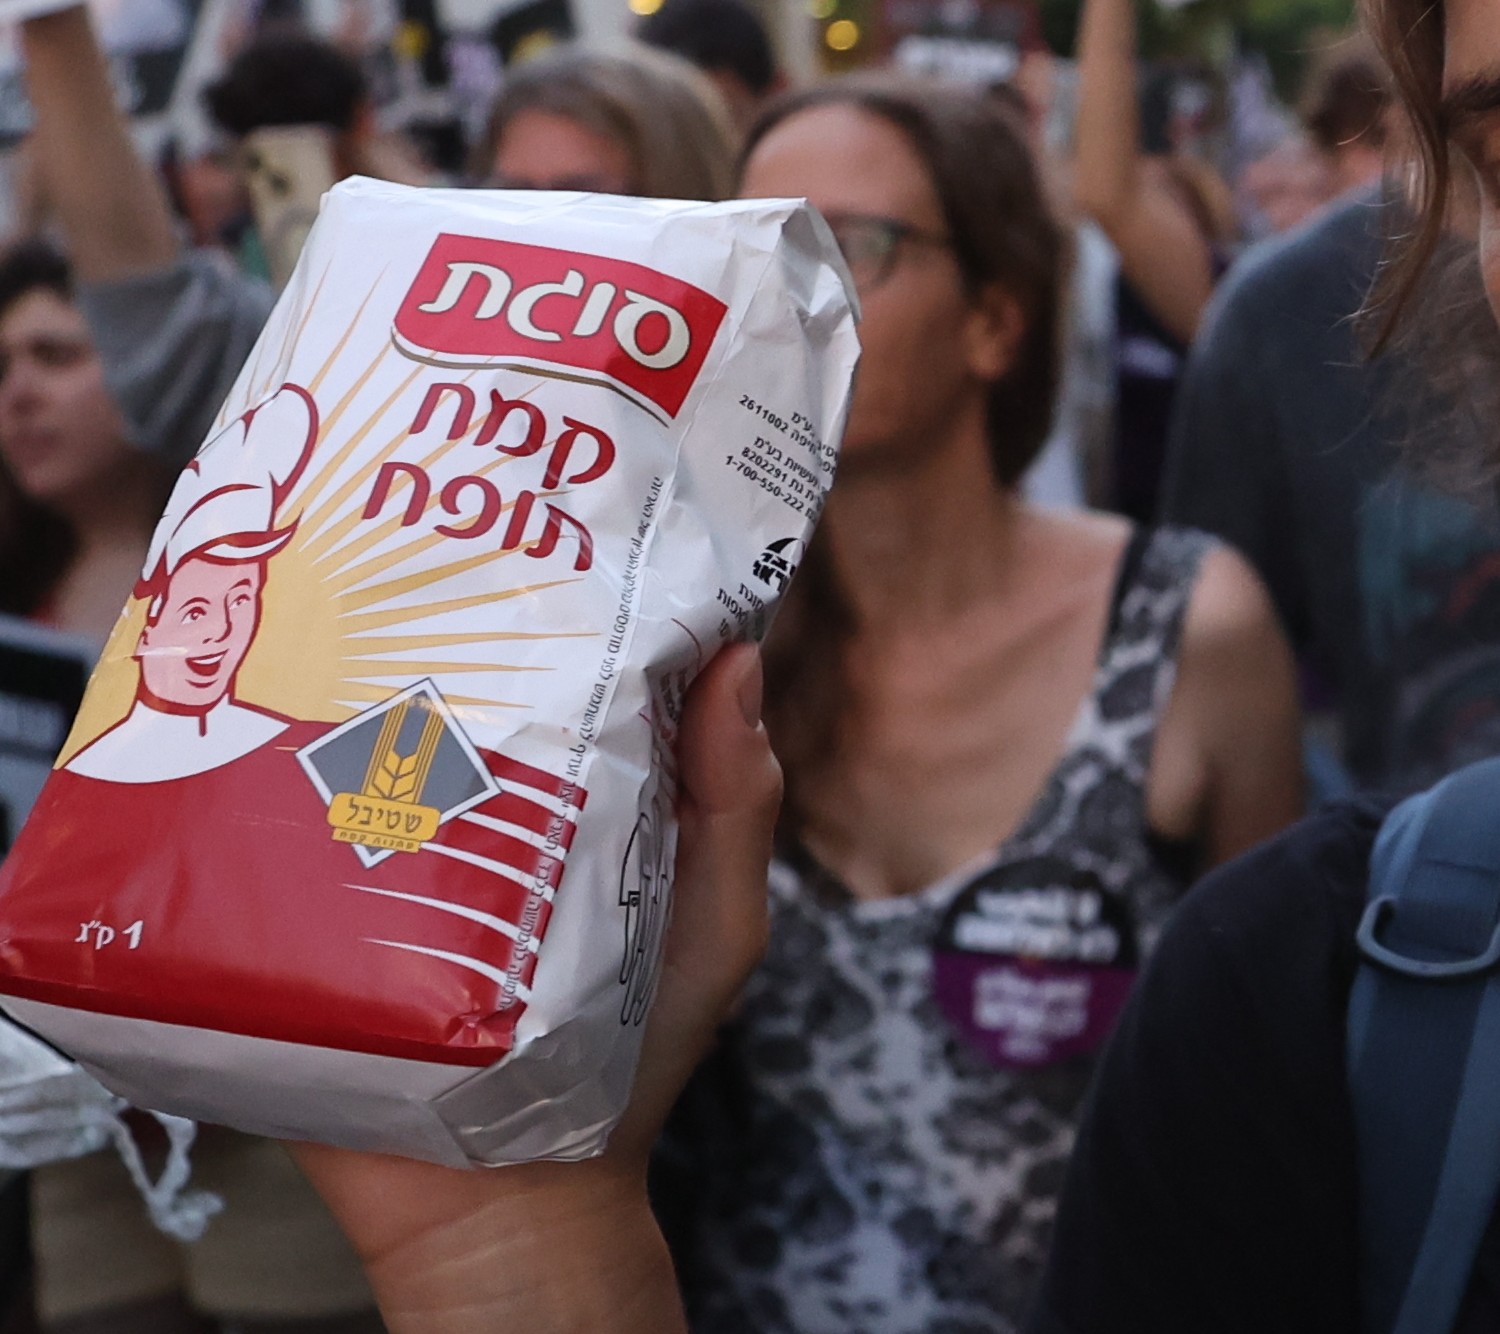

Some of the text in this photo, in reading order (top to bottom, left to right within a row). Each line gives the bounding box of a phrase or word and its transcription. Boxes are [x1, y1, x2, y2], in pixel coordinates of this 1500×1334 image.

[417, 261, 691, 369] סוגת
[739, 394, 789, 433] 2611002
[409, 382, 615, 489] קמח
[754, 436, 783, 462] בע"מ
[725, 455, 803, 513] 1-700-550-222
[741, 447, 788, 483] 8202291
[362, 462, 593, 571] תופח
[641, 475, 664, 519] האריזה
[606, 603, 633, 654] מודפסים
[599, 656, 617, 682] לפני
[578, 681, 606, 742] להשתמש
[565, 742, 587, 777] ועדיף
[346, 797, 422, 833] שטיבל
[74, 920, 144, 950] 1 ק"ג
